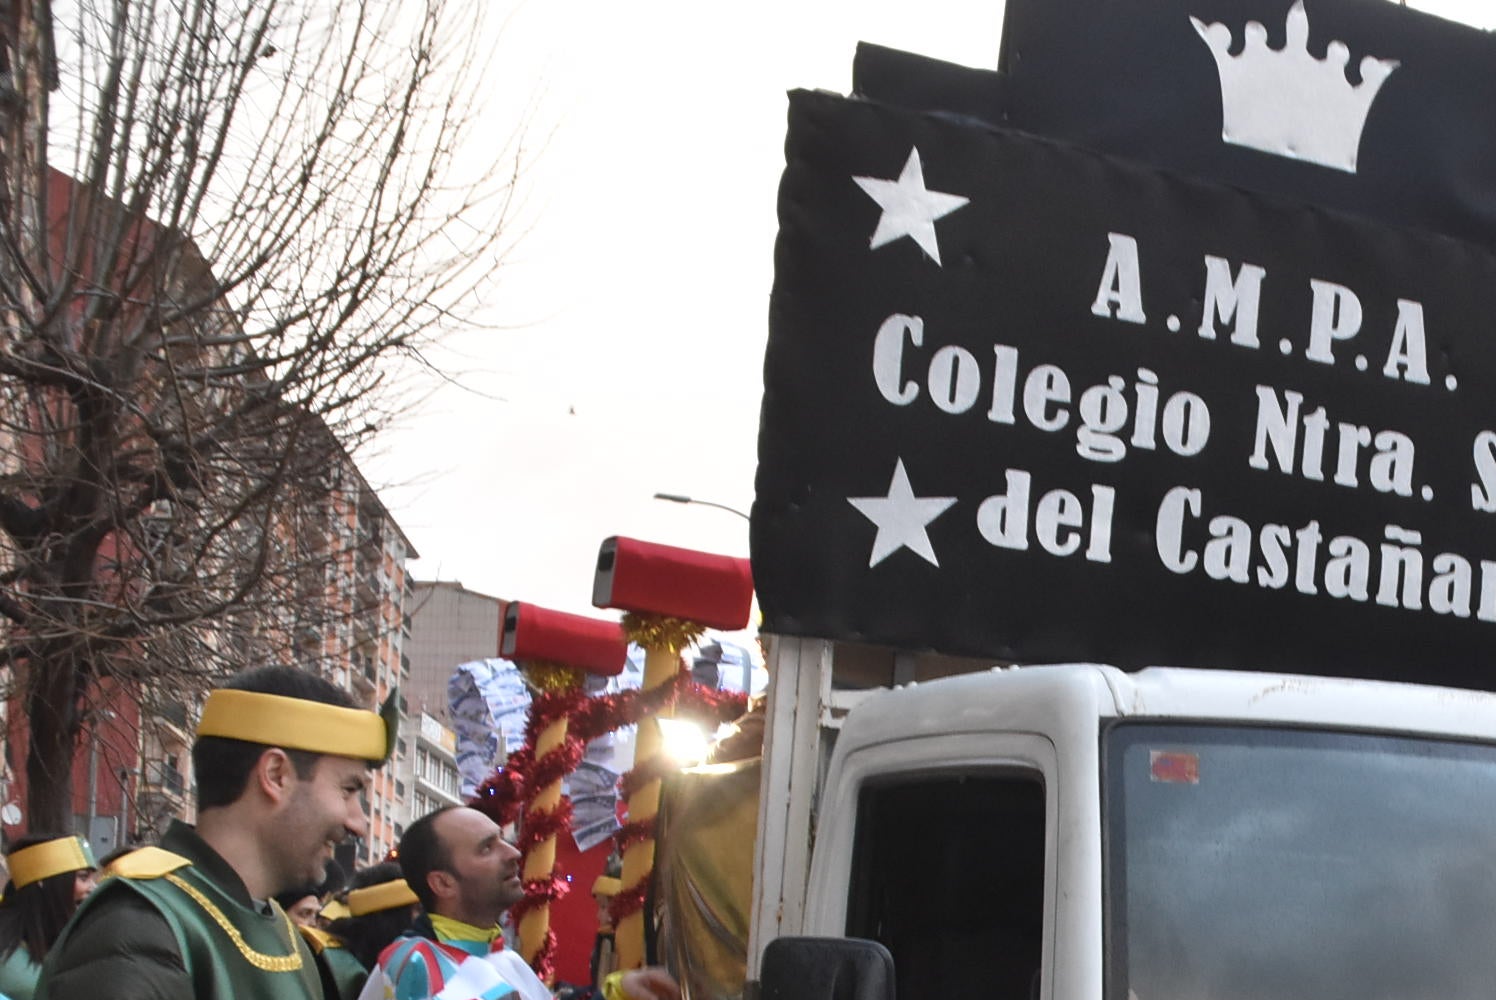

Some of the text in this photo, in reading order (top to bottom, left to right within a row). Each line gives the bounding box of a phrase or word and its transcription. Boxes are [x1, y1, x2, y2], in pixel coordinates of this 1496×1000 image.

[1091, 232, 1458, 391] A.M.P.A.
[873, 314, 1211, 462] Colegio
[1249, 386, 1434, 501] Ntra.
[977, 469, 1116, 562] del
